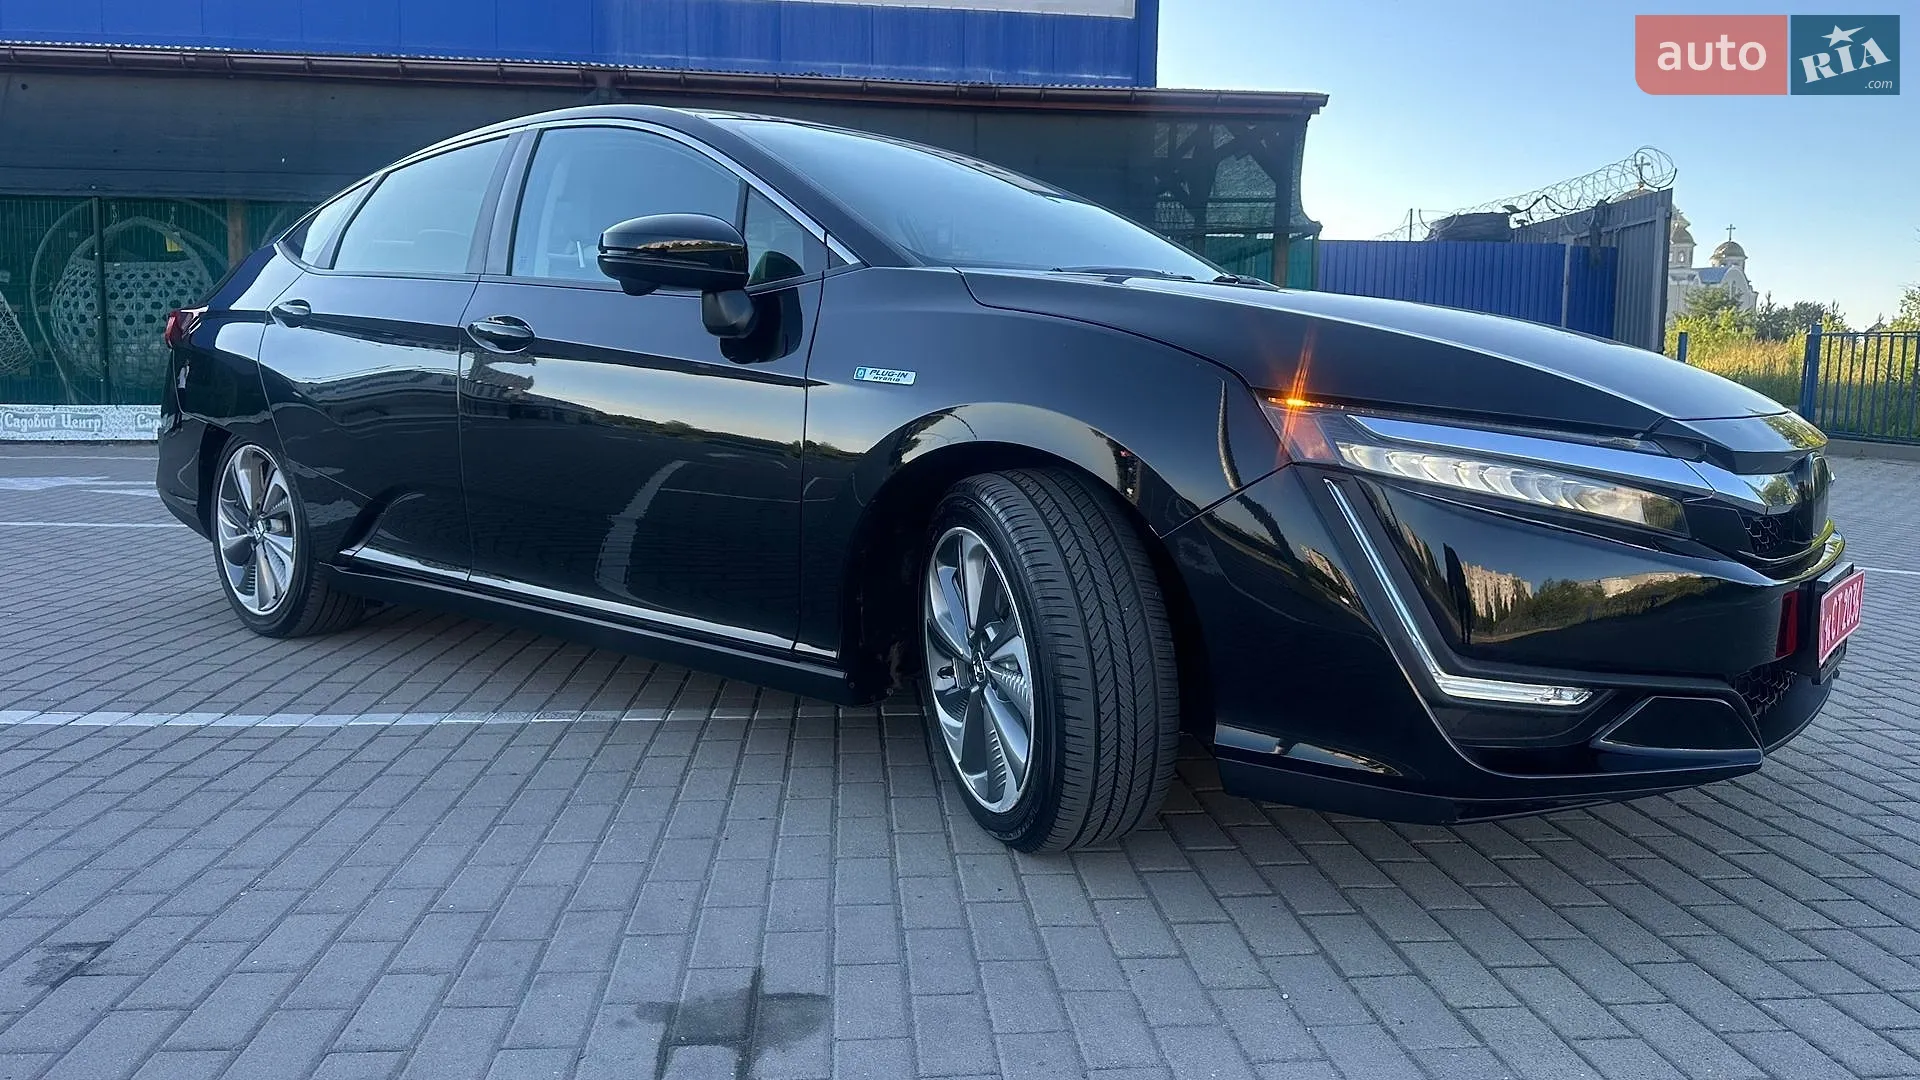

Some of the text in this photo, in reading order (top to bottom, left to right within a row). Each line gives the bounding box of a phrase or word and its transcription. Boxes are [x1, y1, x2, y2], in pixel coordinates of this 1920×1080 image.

[869, 369, 909, 379] PLUG-IN
[4, 412, 101, 433] Садовий Центр
